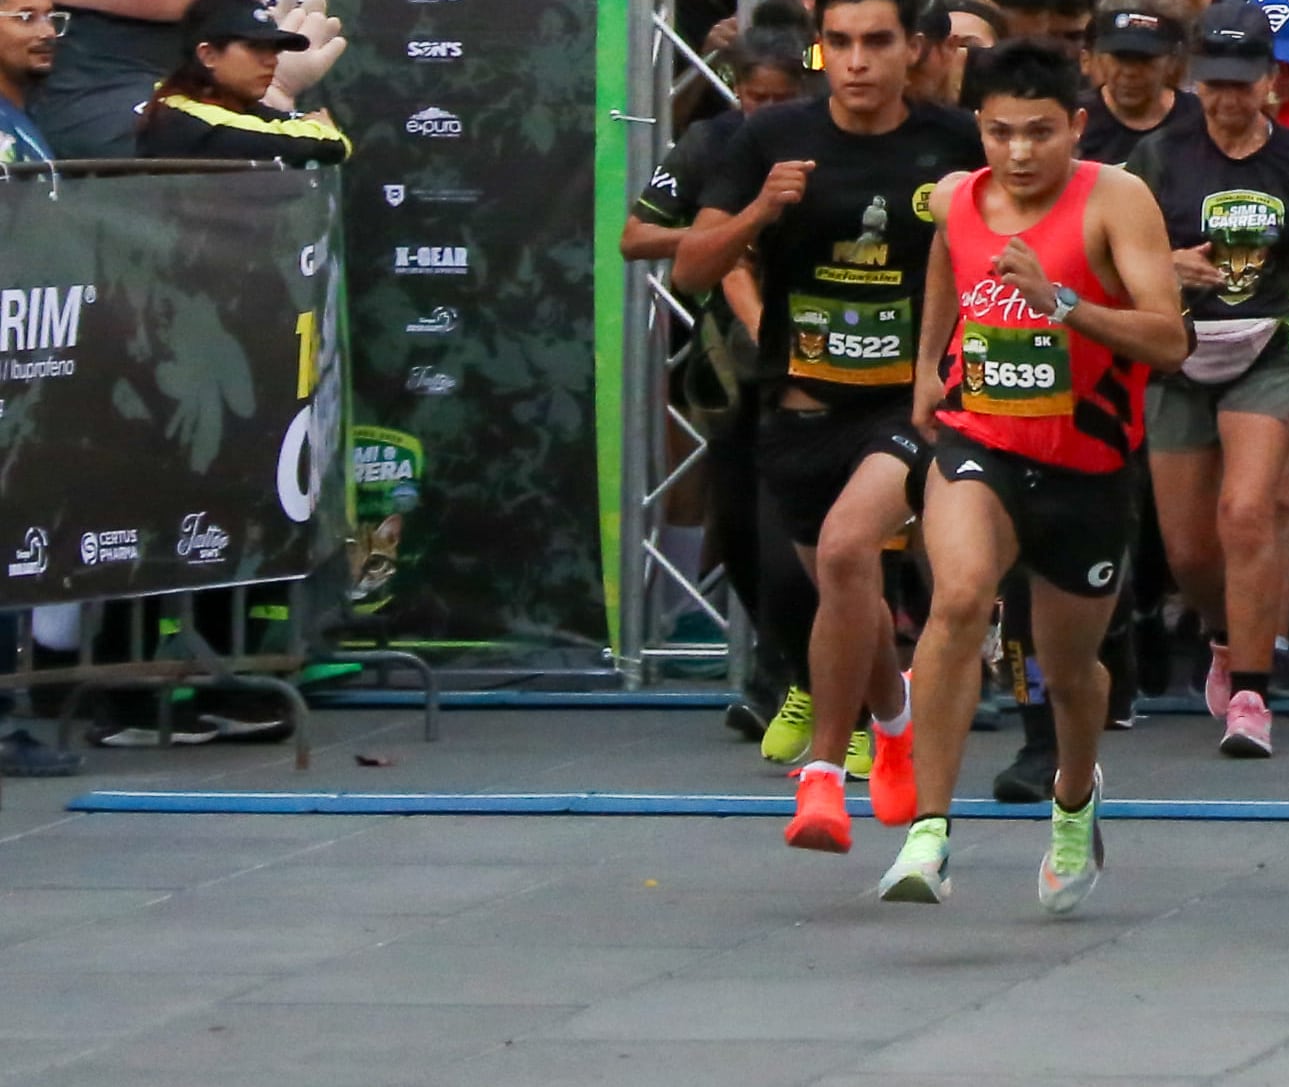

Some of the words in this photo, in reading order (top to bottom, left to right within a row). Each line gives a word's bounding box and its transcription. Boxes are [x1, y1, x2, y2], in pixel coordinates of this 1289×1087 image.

[1208, 213, 1276, 228] CARRERA
[880, 311, 895, 321] 5K
[828, 332, 900, 358] 5522
[1034, 336, 1051, 347] 5K
[10, 356, 75, 383] Ibuprofeno
[984, 361, 1055, 388] 5639
[100, 530, 138, 545] CERTUS
[100, 546, 138, 562] PHARMA
